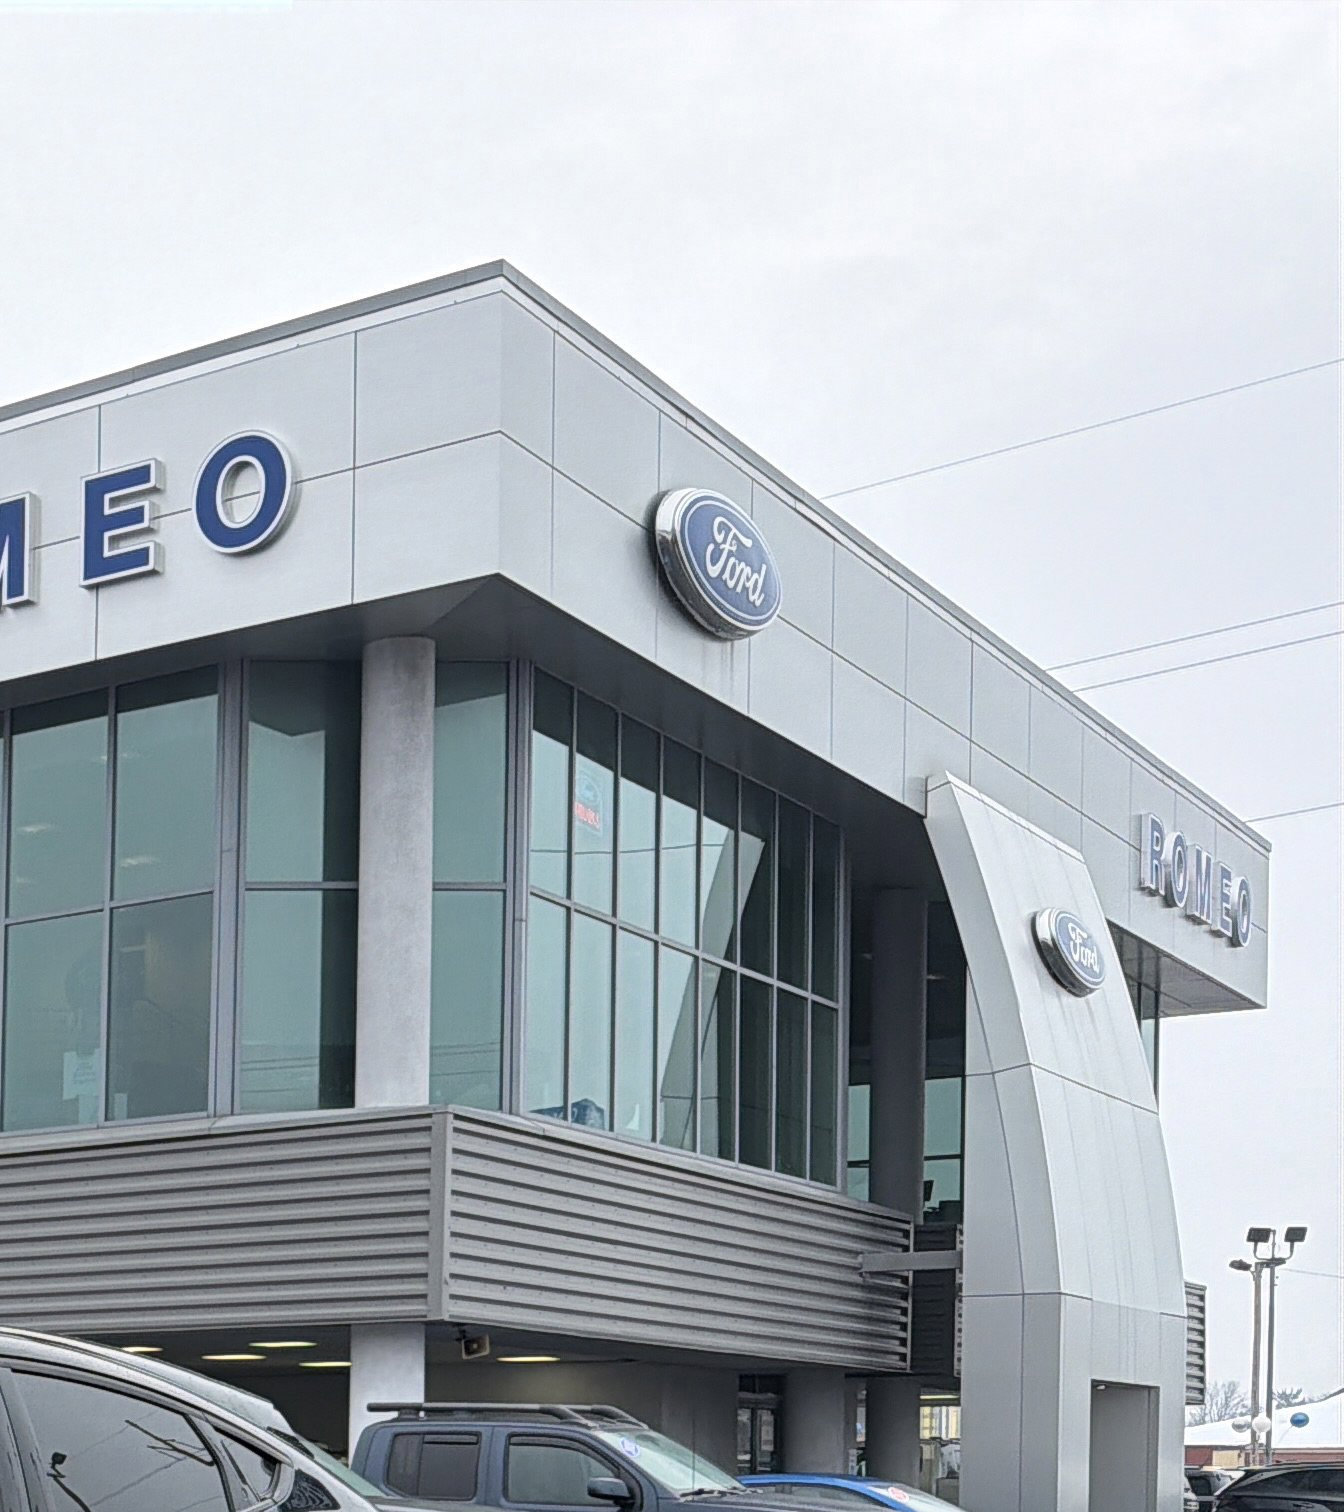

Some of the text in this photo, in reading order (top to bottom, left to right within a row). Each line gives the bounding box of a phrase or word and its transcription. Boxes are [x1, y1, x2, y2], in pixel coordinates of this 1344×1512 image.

[706, 516, 767, 608] Ford
[1141, 812, 1252, 947] ROMEO
[1067, 922, 1100, 975] Ford
